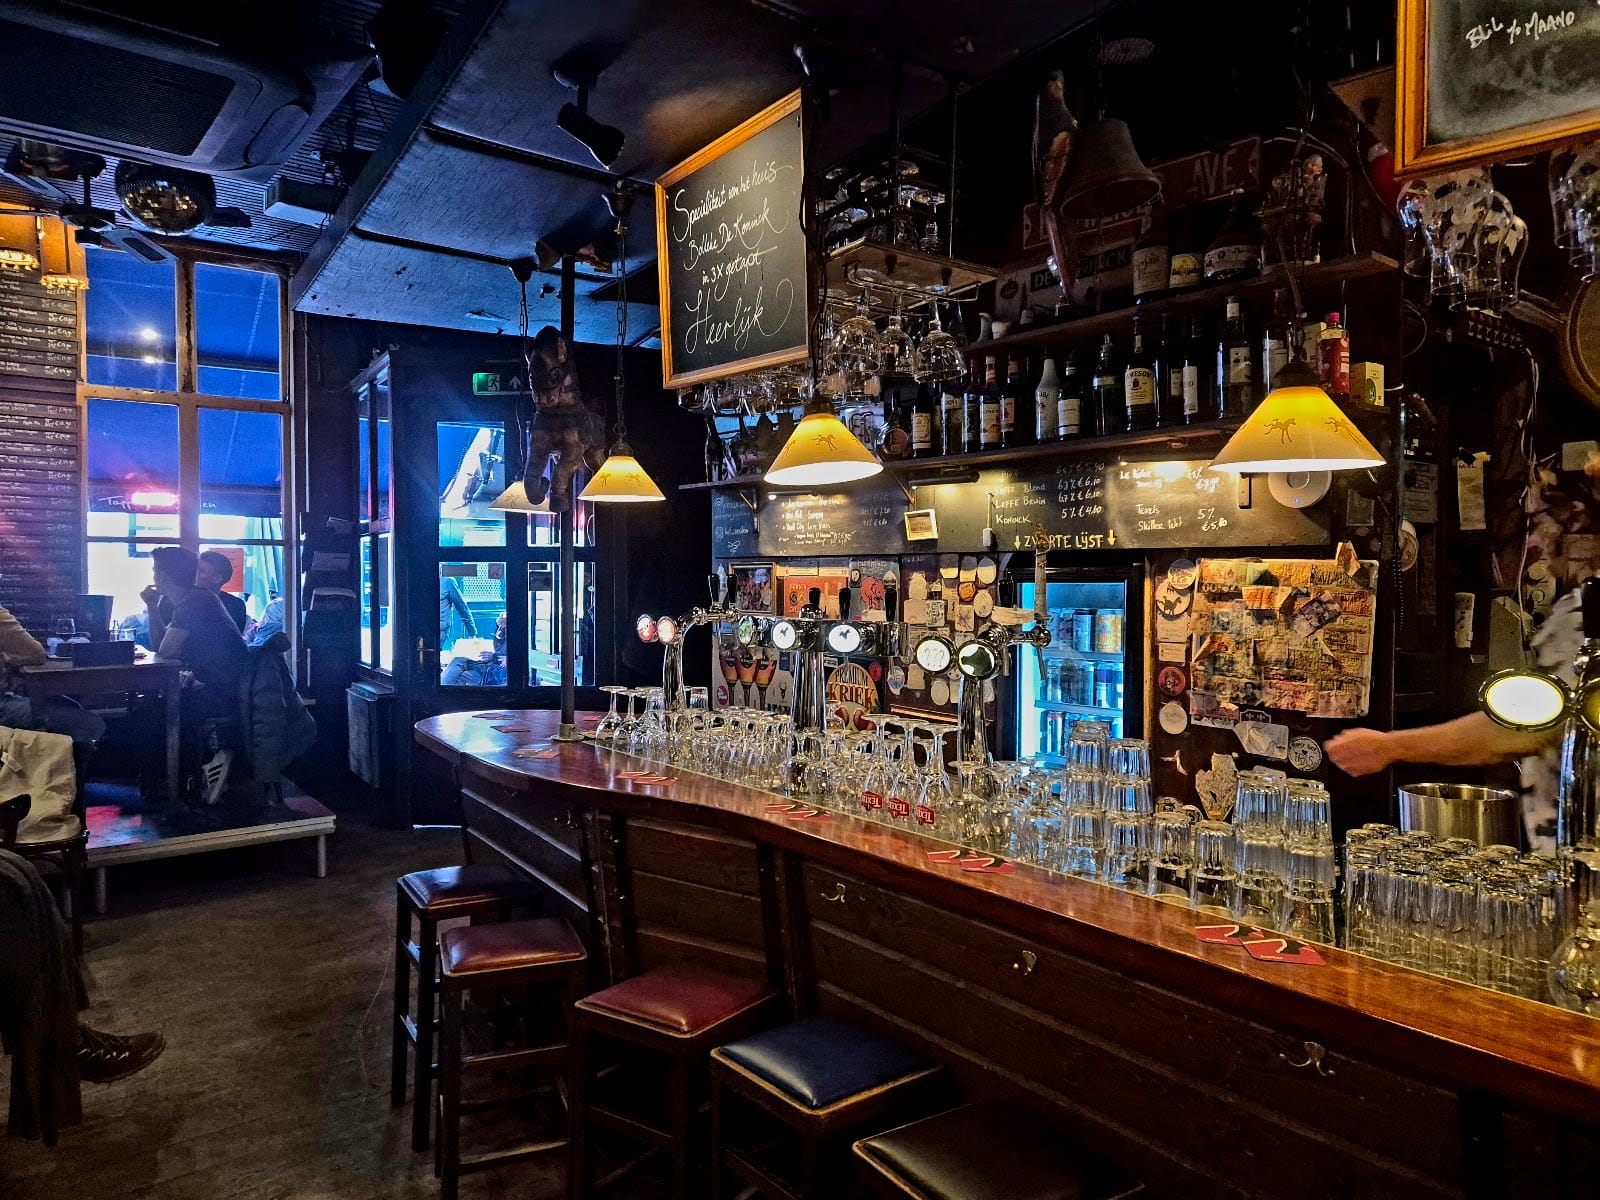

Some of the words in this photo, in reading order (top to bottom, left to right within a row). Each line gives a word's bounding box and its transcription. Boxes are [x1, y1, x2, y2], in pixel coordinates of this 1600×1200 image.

[752, 160, 790, 185] huis
[717, 222, 733, 253] De
[702, 270, 709, 285] in
[1024, 535, 1072, 548] ZRTE
[828, 682, 876, 710] KRIEK
